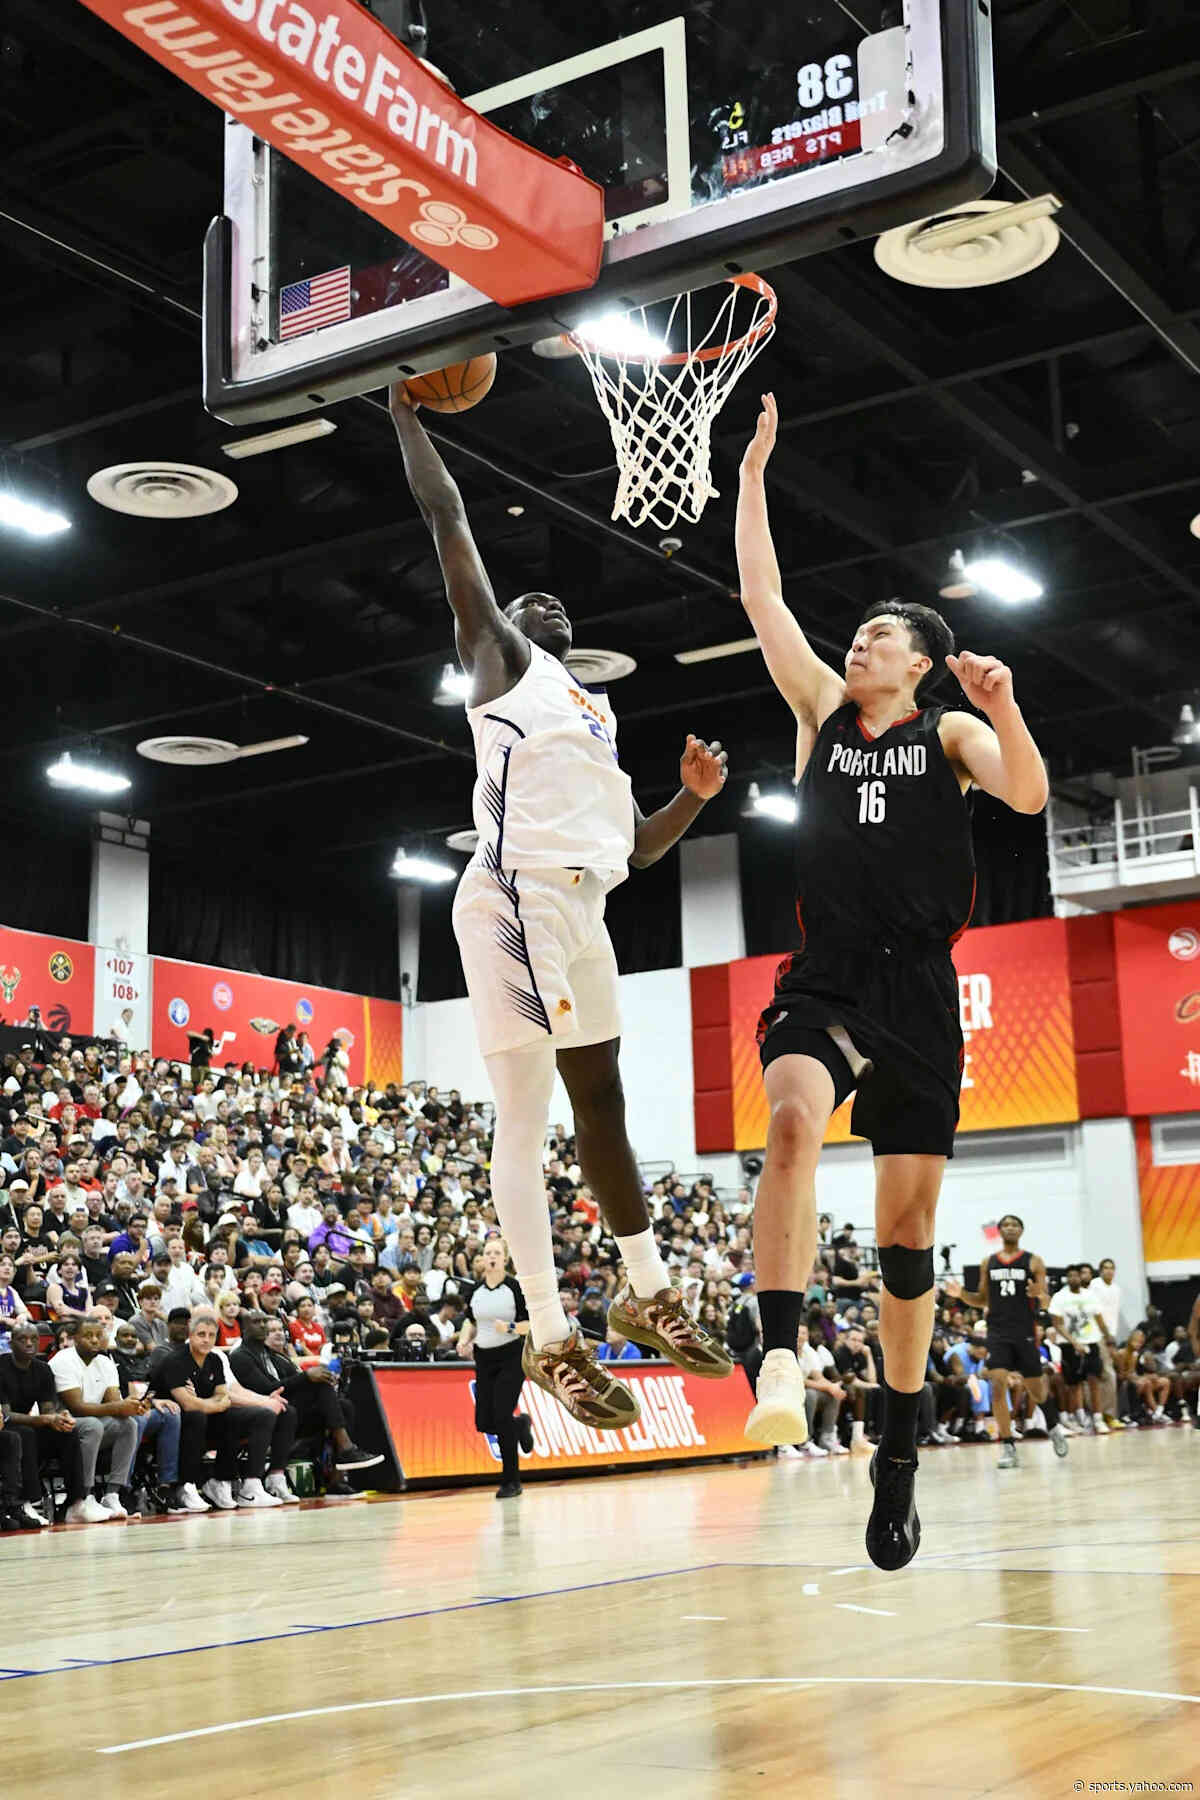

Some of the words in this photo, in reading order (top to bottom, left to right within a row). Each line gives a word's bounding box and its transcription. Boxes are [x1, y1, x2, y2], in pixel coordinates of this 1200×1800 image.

[827, 743, 927, 777] PORTLAND
[856, 780, 886, 824] 16
[113, 958, 134, 975] 107
[113, 983, 133, 1001] 108
[1000, 1280, 1016, 1296] 24
